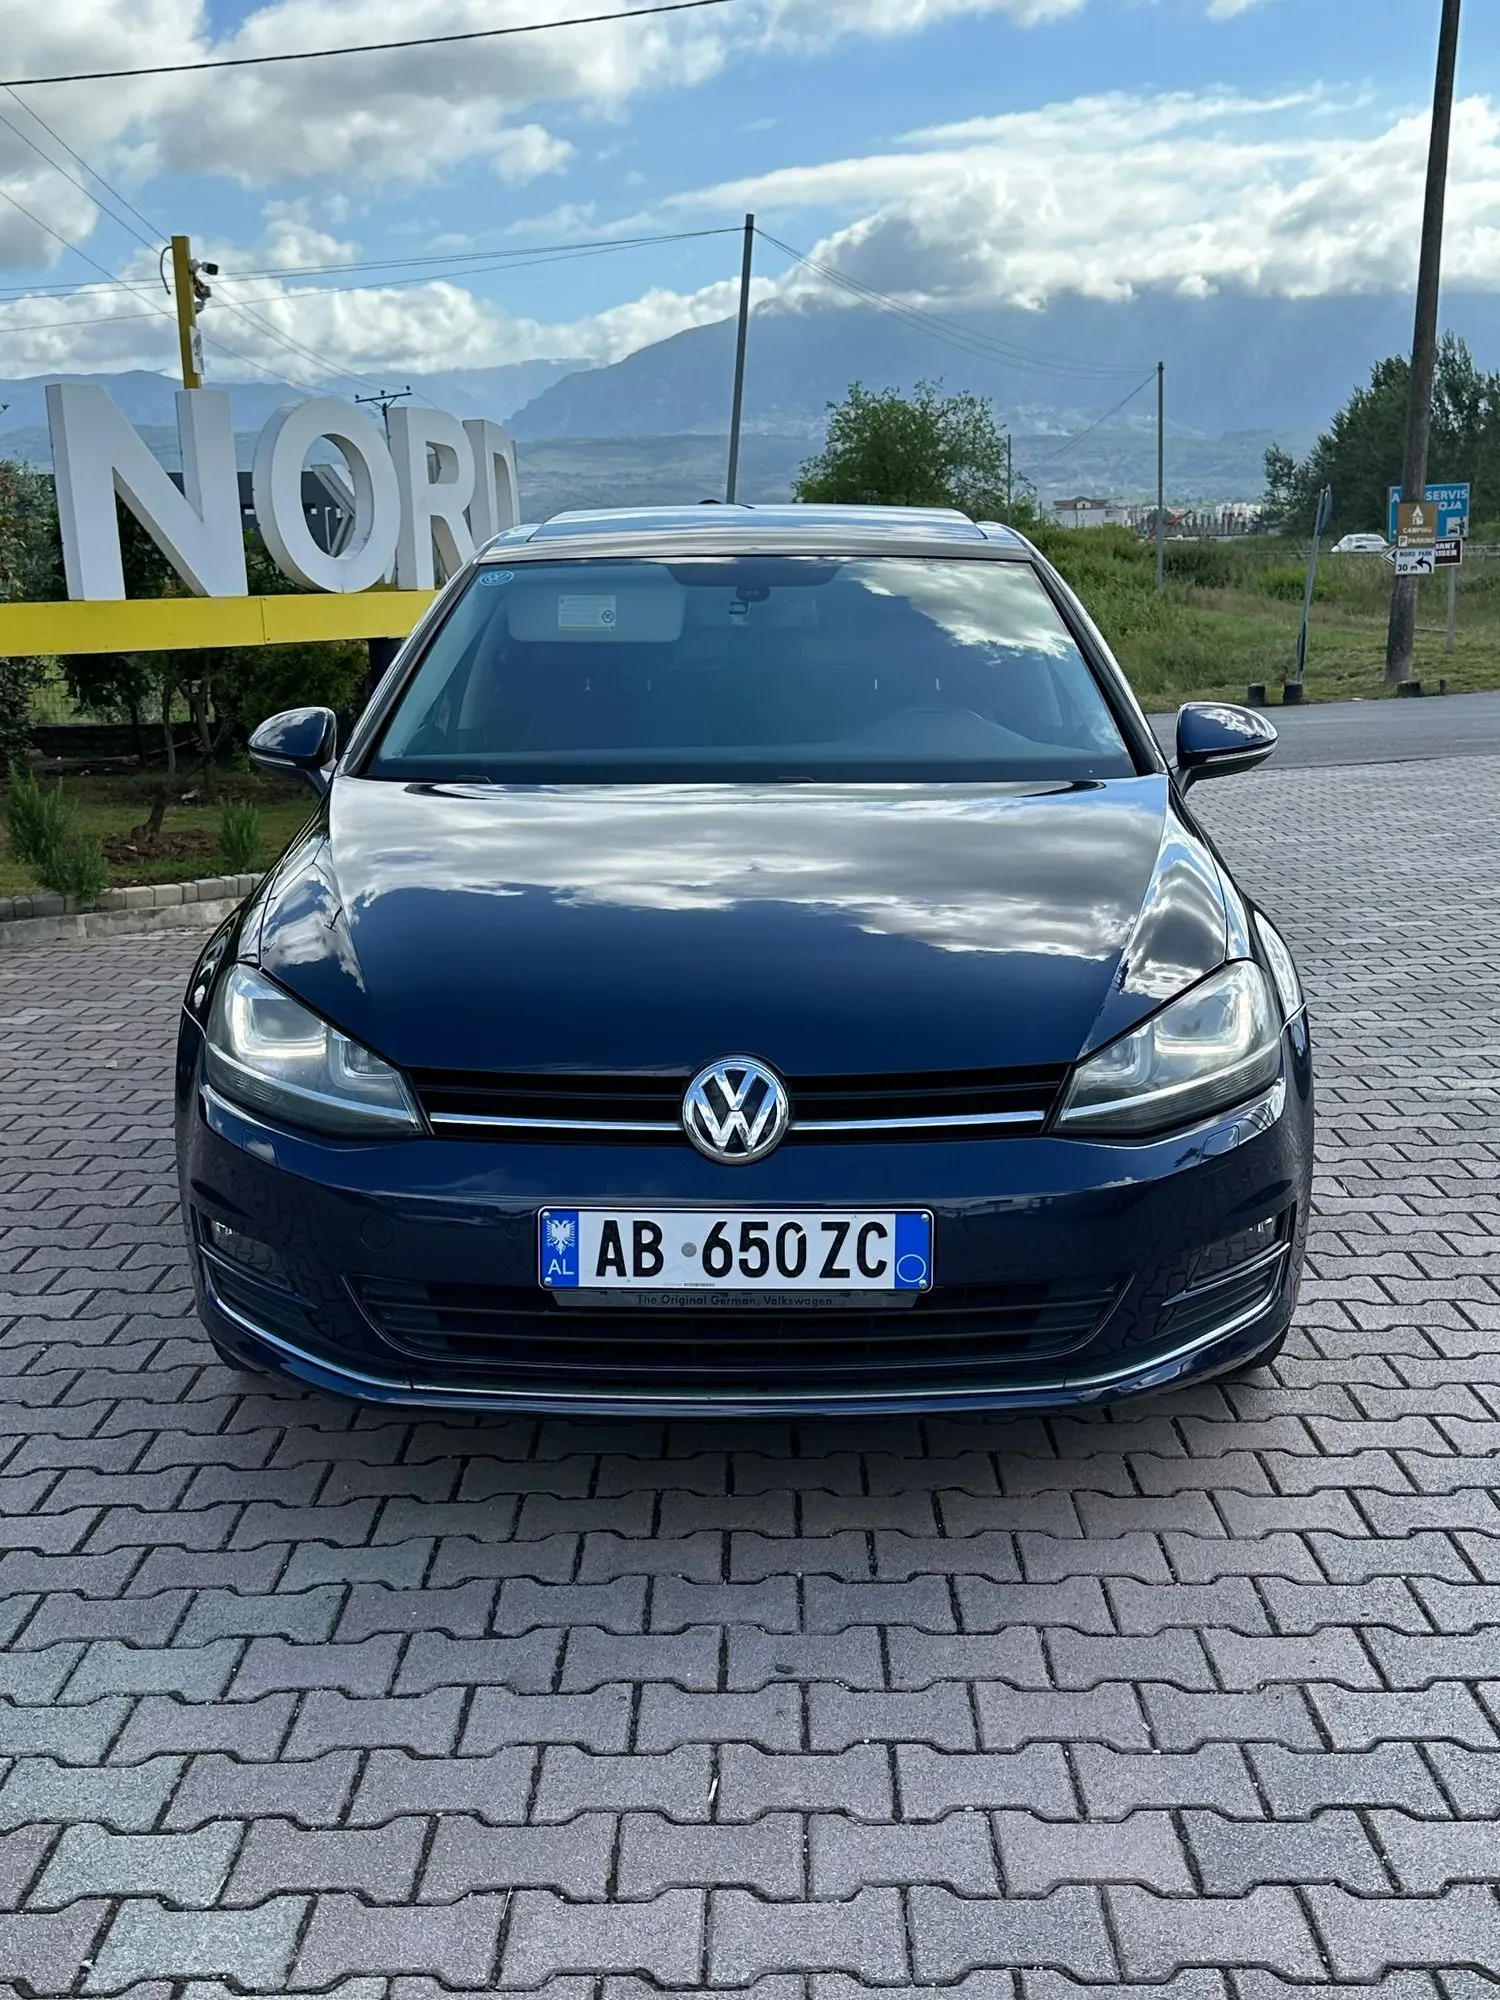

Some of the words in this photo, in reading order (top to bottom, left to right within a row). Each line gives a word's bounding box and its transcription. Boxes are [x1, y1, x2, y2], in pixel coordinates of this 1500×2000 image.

[46, 382, 521, 600] NORD
[1425, 489, 1468, 501] SERVIS
[1397, 564, 1408, 572] 30
[596, 1219, 664, 1278] AB
[547, 1258, 574, 1276] AL
[637, 1294, 656, 1304] The
[661, 1294, 707, 1307] Original
